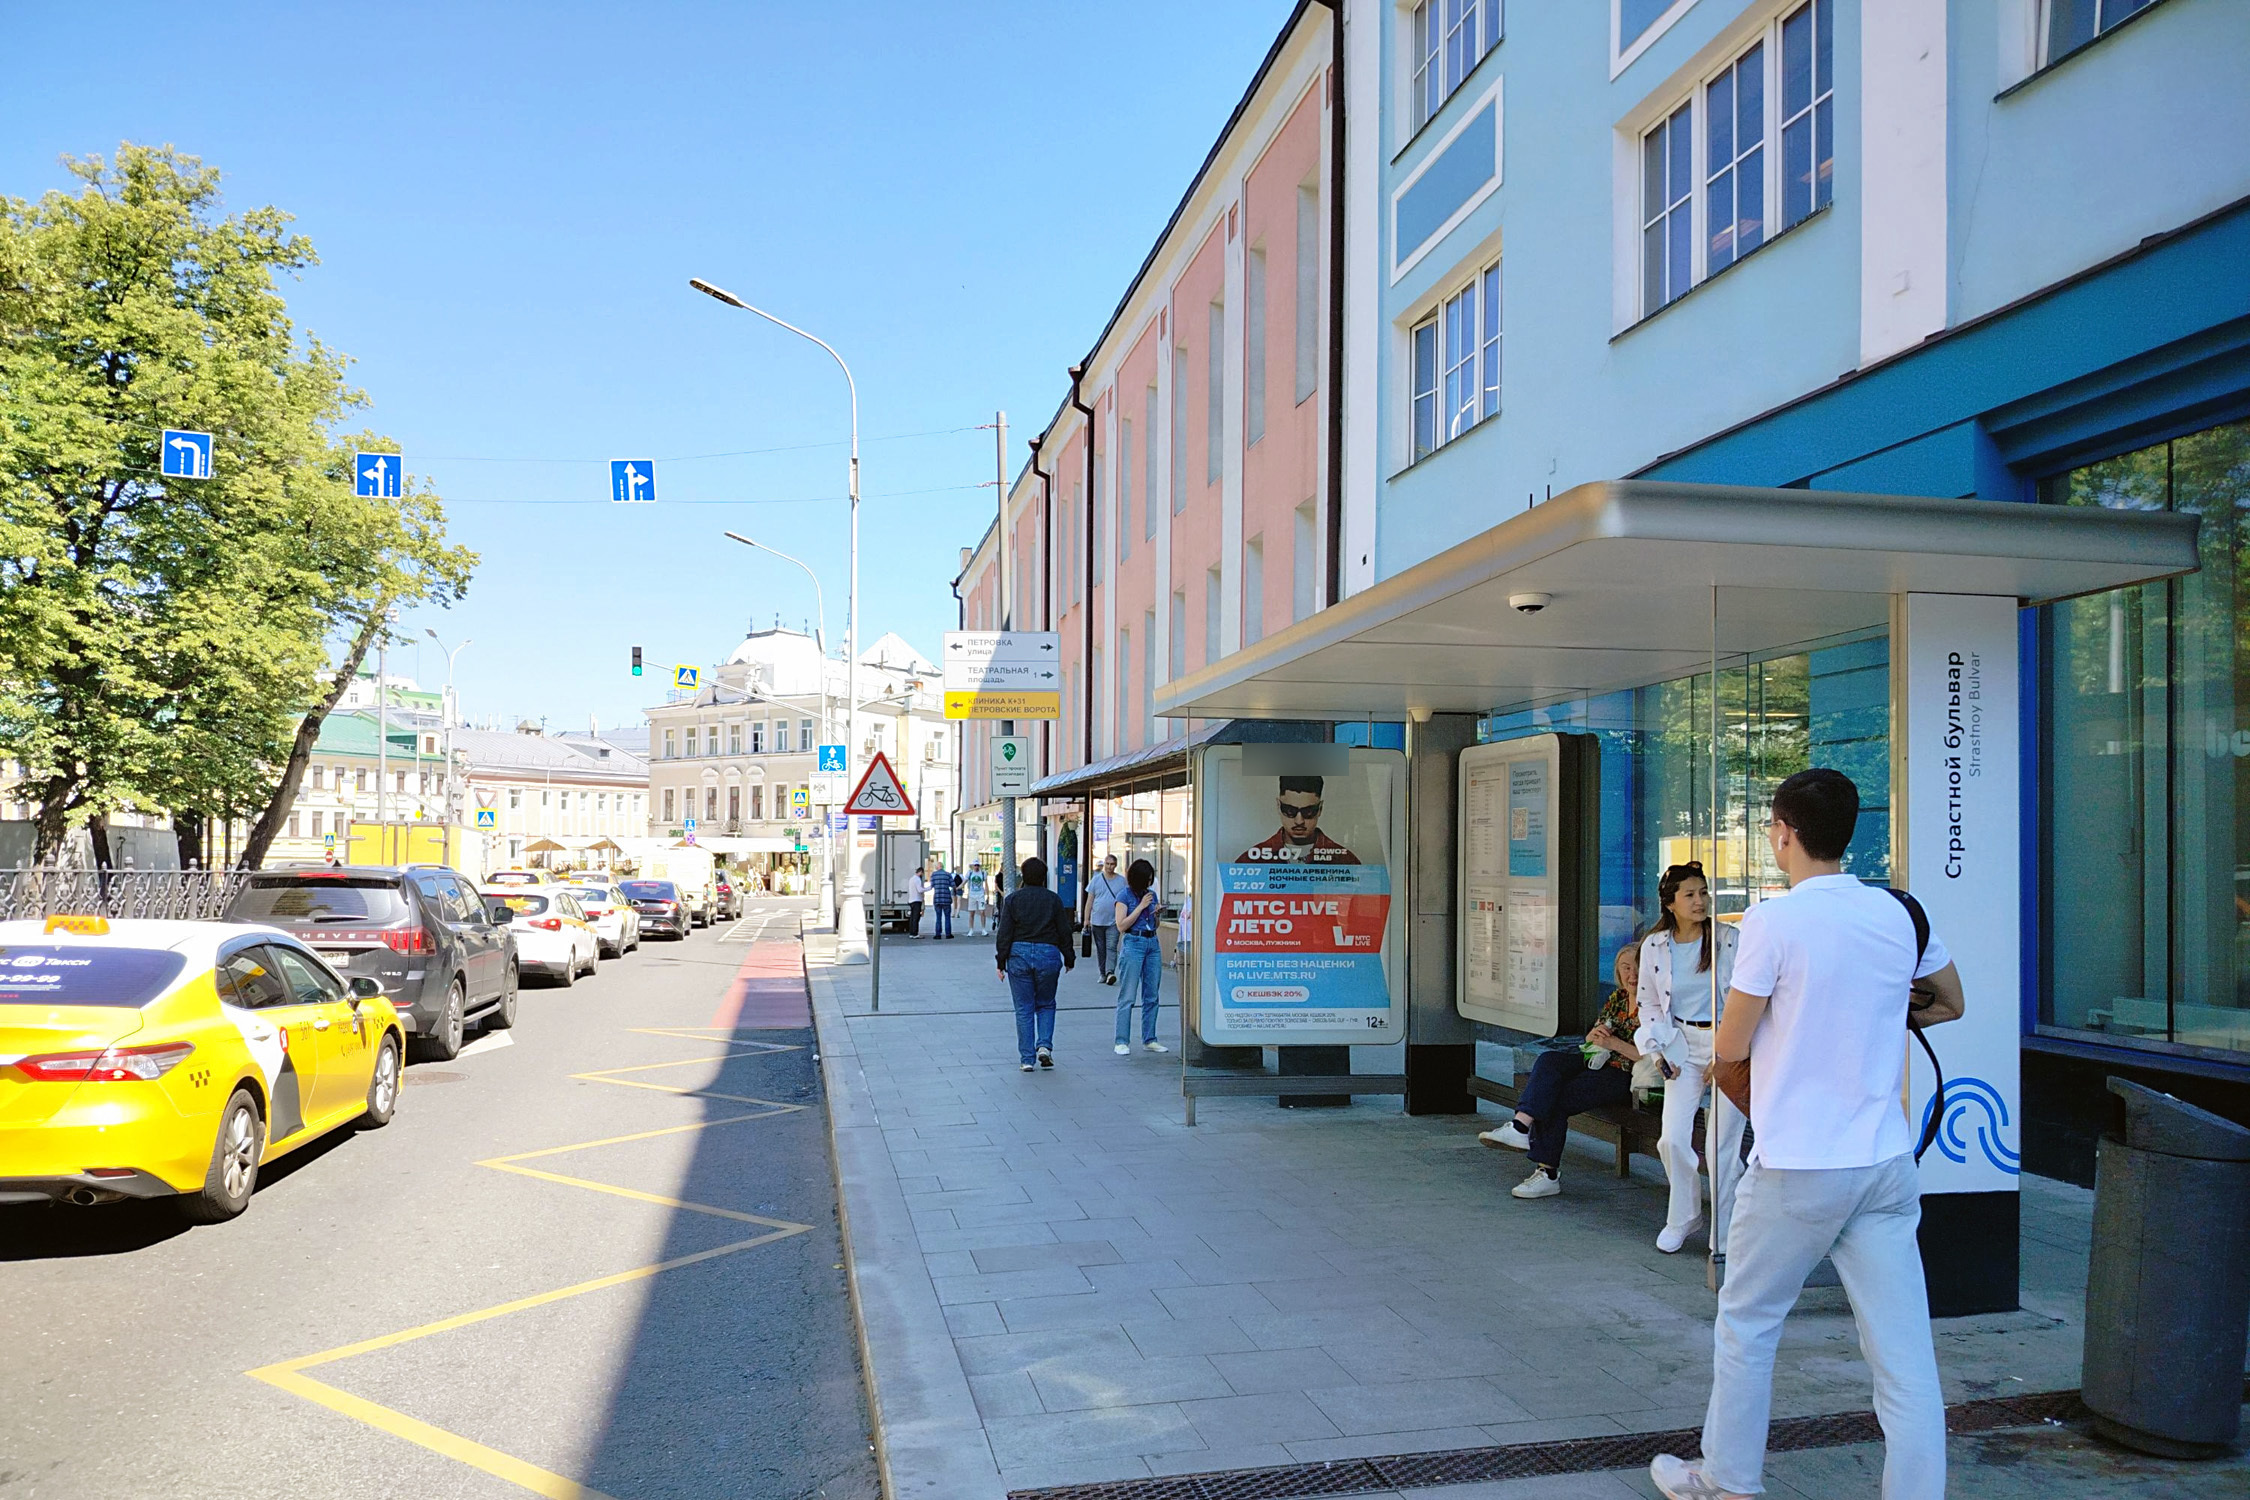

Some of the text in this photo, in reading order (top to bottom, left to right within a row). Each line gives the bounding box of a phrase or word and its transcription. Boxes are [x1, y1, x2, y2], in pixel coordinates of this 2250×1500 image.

[1968, 652, 1983, 777] Strastnoy Bulvar
[1944, 651, 1965, 879] Страстной бульвар
[1248, 847, 1302, 860] 05.07
[1229, 868, 1261, 876] 07.07
[1309, 875, 1360, 883] СНАЙПЕРЫ
[1233, 881, 1266, 890] 27.07
[1233, 900, 1339, 916] МТС LIVE
[1228, 919, 1293, 934] ЛЕТО
[45, 958, 92, 966] Такси
[1301, 961, 1355, 970] НАЦЕНКИ
[1228, 972, 1316, 980] НА LIVE.MTS.RU
[1366, 1016, 1385, 1029] 12+
